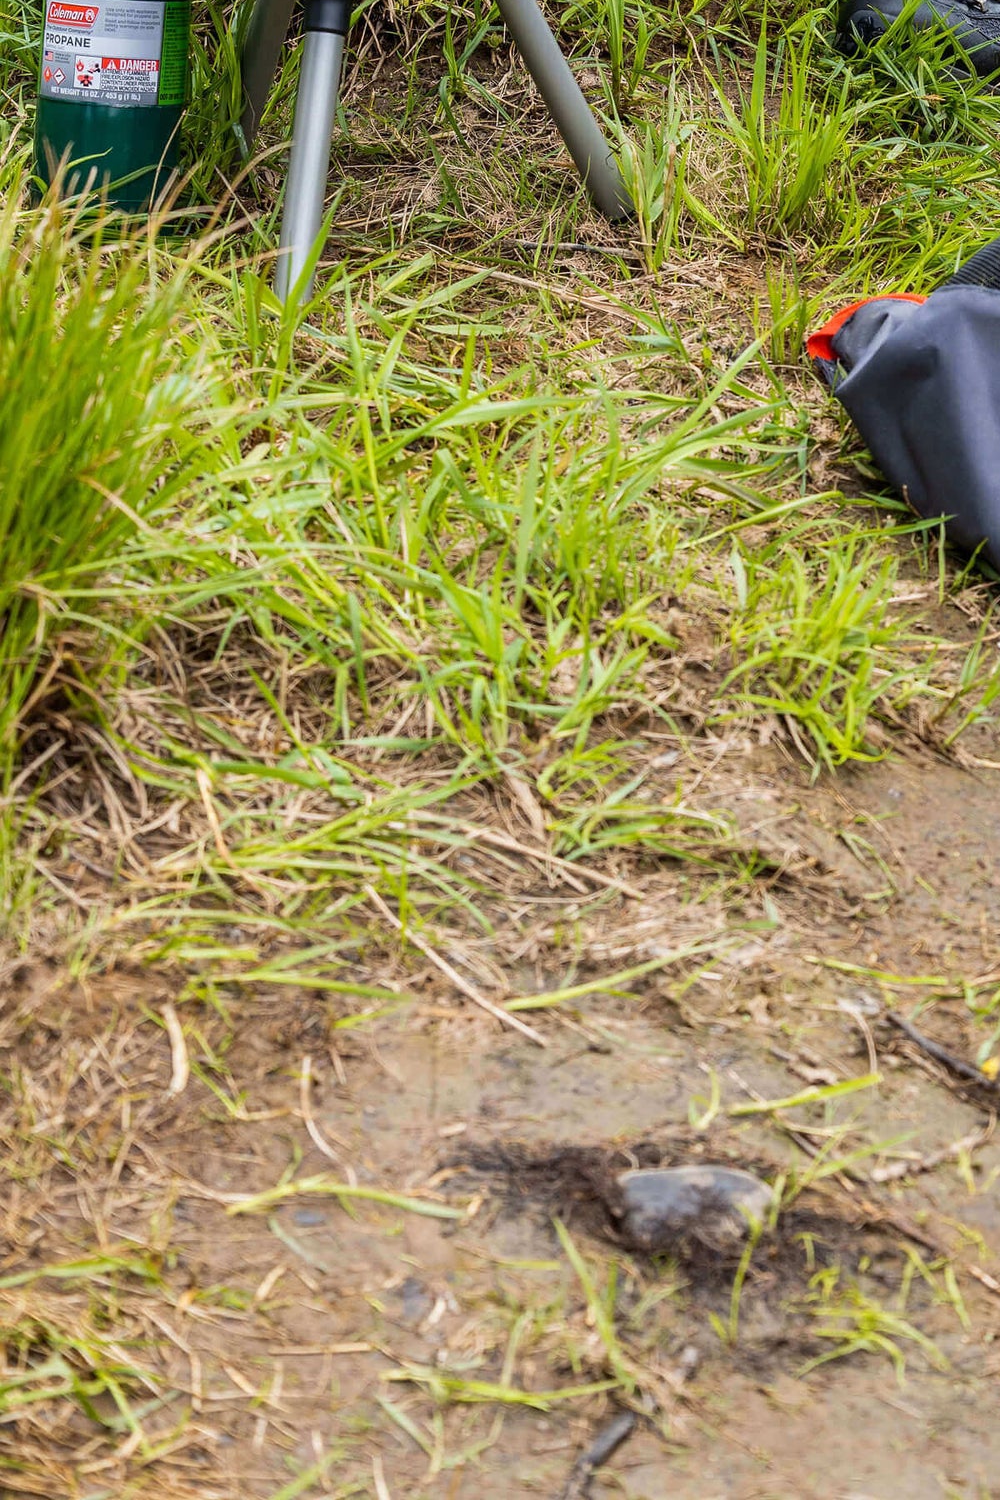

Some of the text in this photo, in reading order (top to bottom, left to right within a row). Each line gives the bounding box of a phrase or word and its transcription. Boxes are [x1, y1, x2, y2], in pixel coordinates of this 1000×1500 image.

[50, 4, 84, 20] Coleman
[46, 33, 91, 47] PROPANE
[120, 60, 157, 71] DANGER
[60, 88, 79, 96] WEIGHT
